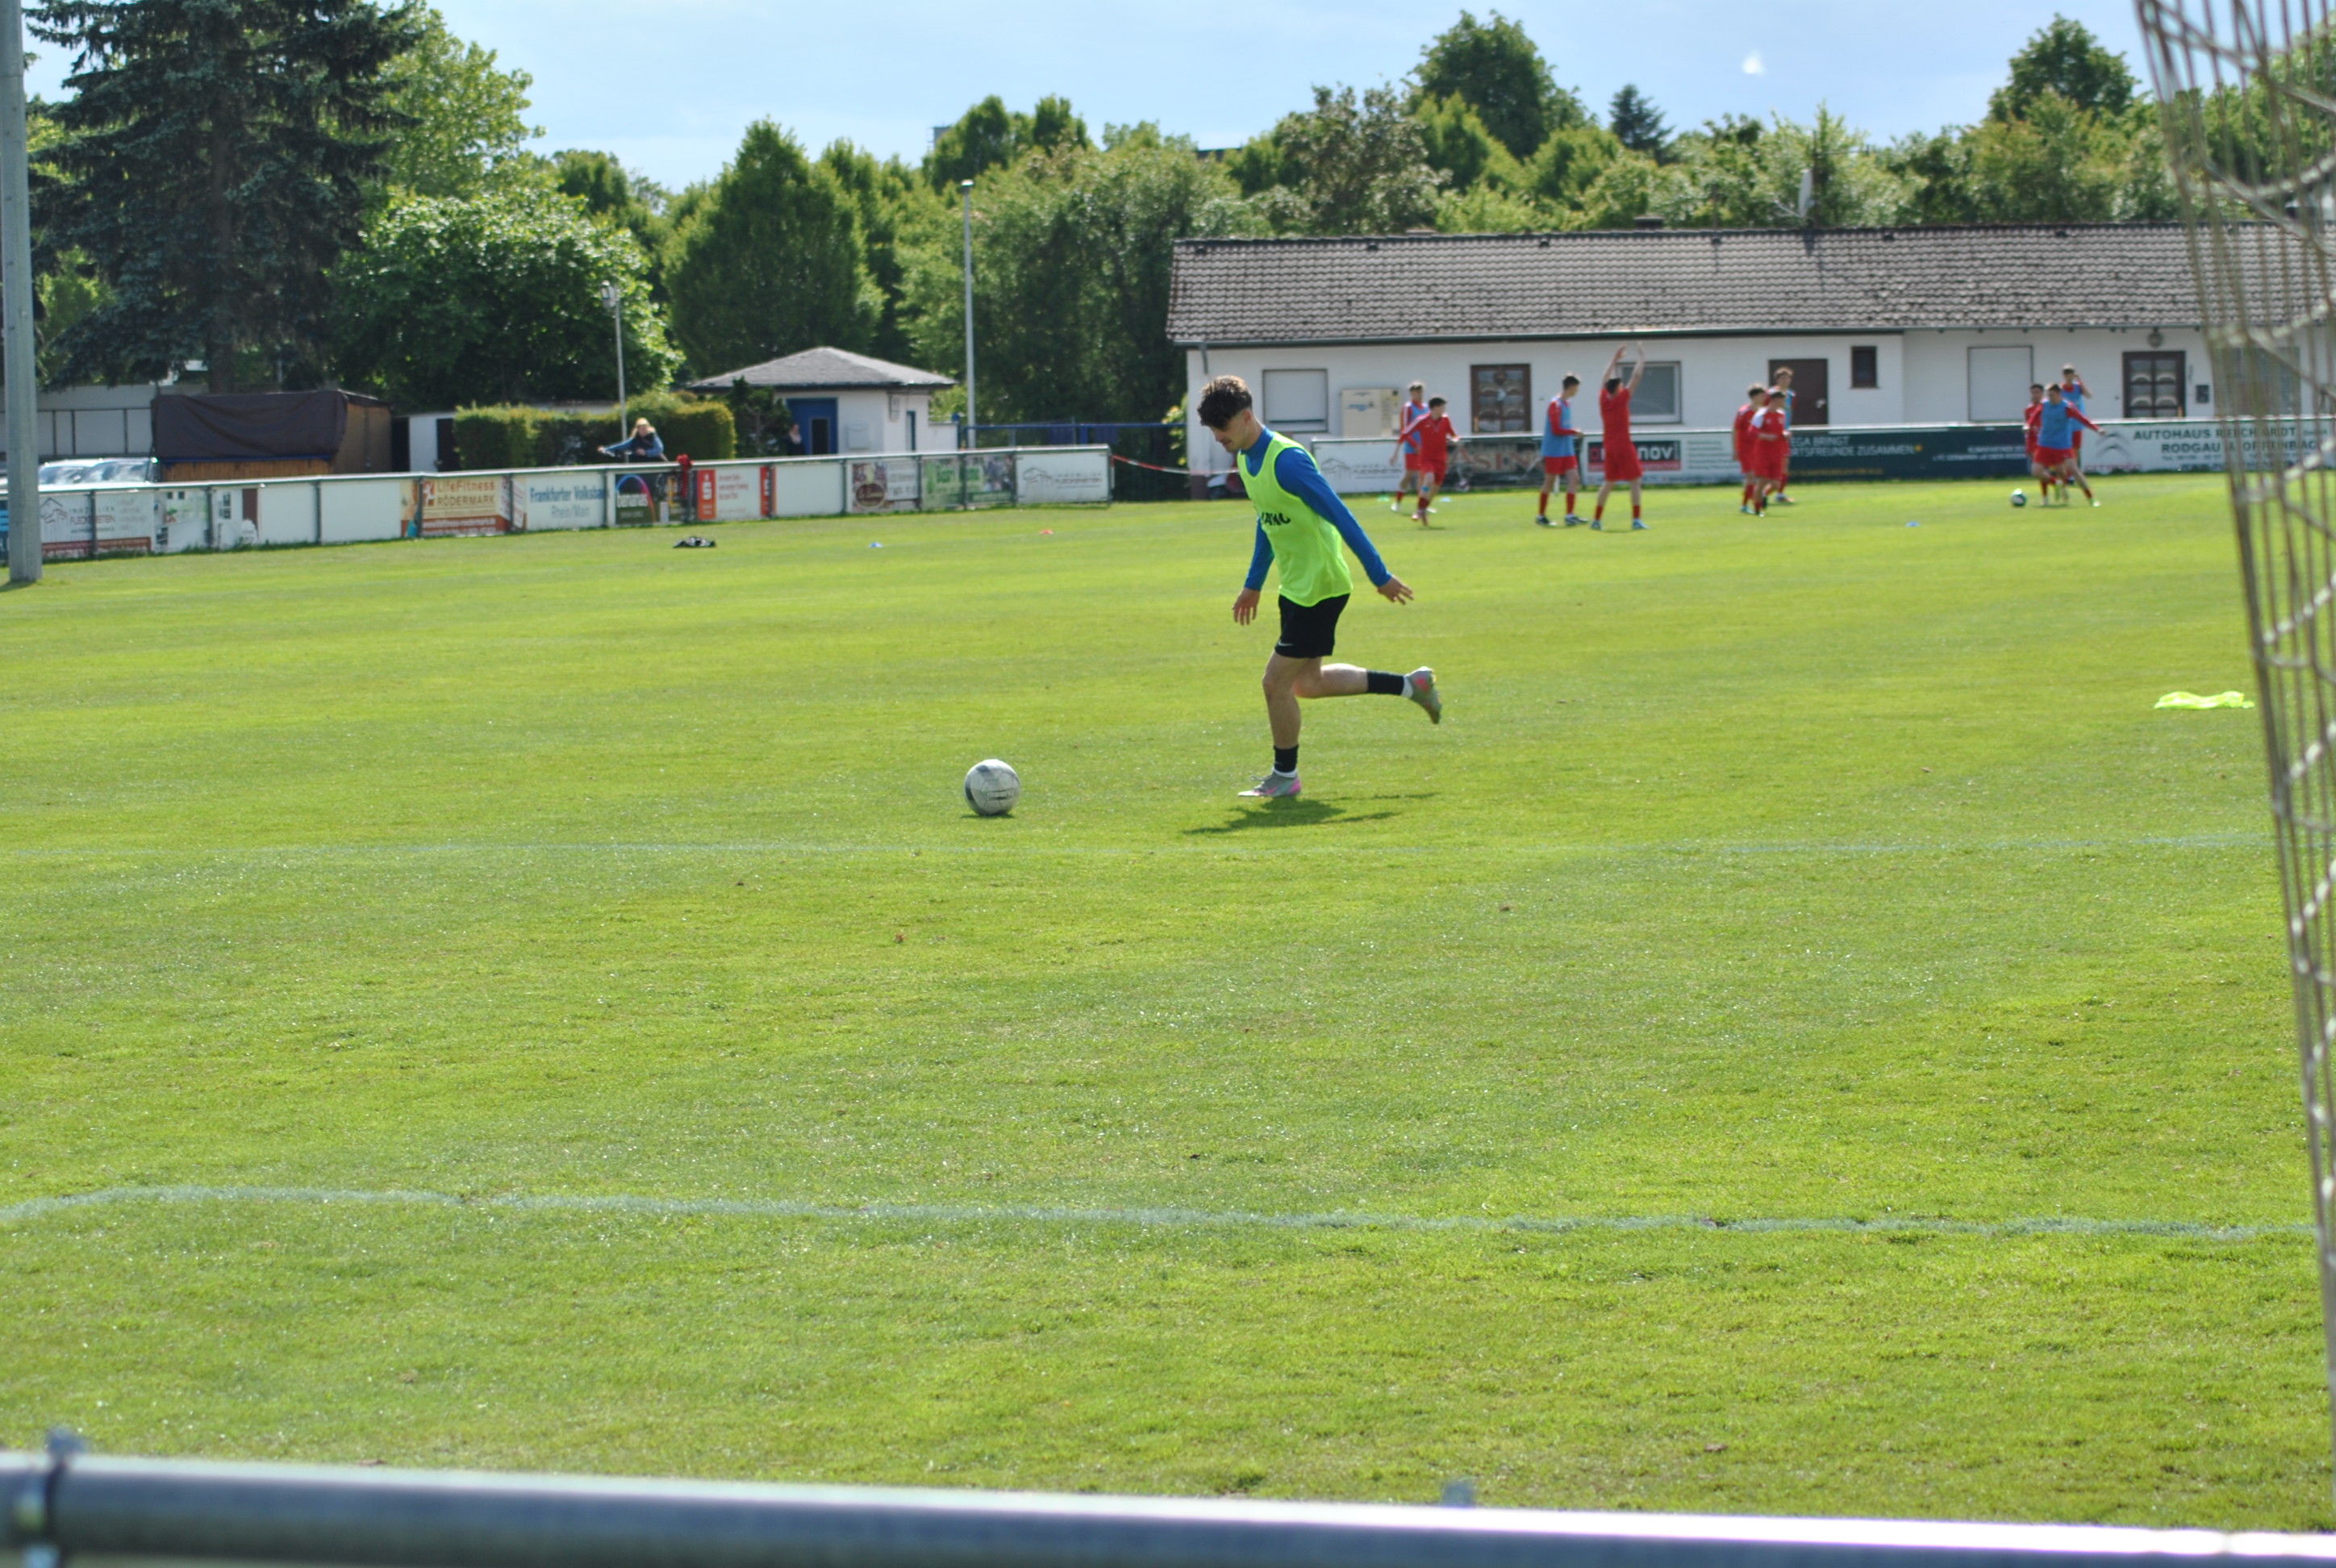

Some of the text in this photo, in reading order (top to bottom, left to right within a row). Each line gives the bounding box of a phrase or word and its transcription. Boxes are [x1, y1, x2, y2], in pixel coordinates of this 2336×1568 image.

[2133, 429, 2211, 440] AUTOHAUS
[2161, 443, 2221, 453] RODGAU
[437, 479, 495, 493] LifeFitness
[437, 494, 495, 507] RÖDERMARK
[529, 487, 572, 503] Frankfurter
